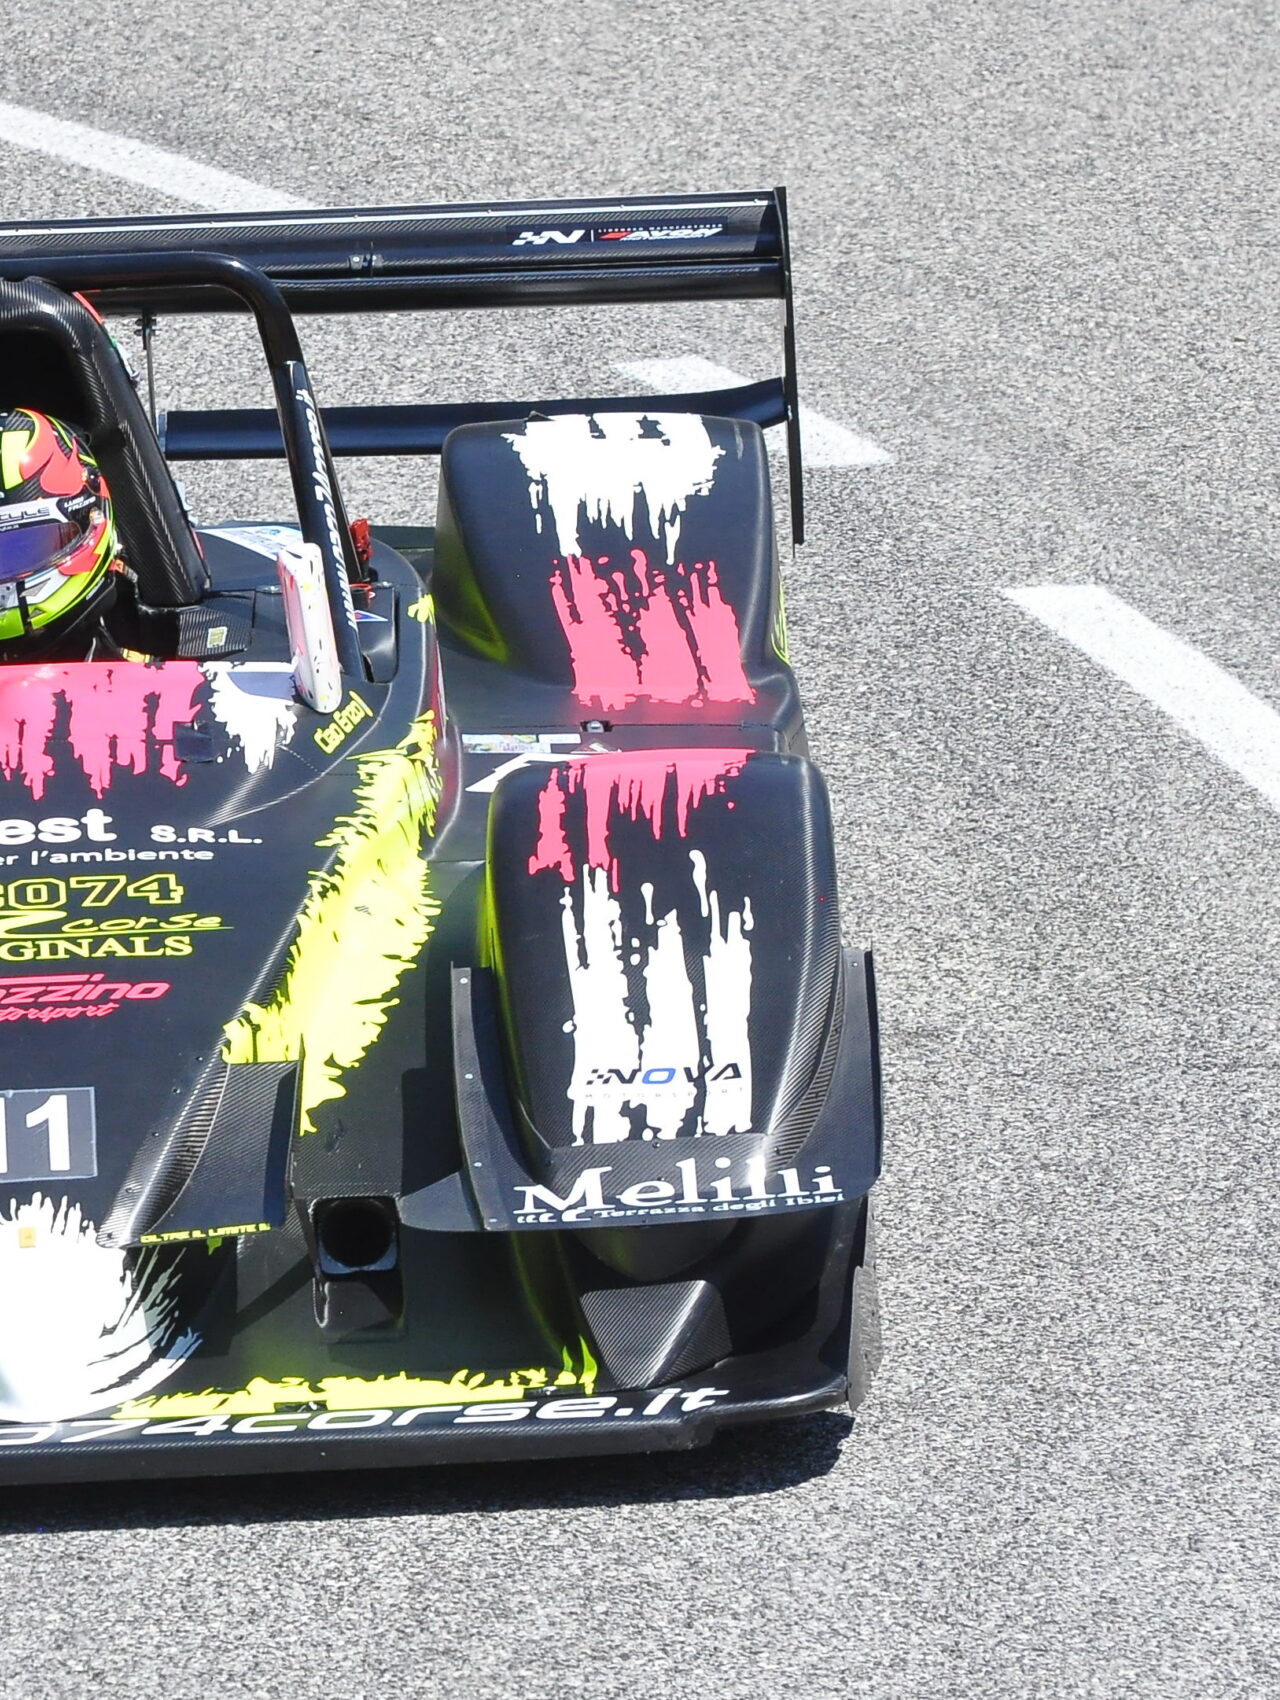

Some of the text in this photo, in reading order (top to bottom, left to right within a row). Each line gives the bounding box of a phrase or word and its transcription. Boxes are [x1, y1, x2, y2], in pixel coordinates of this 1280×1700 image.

[150, 824, 263, 844] S.R.L.
[31, 847, 214, 866] l'ambiente
[61, 912, 223, 934] corse
[600, 1062, 742, 1085] NOVA
[513, 1156, 842, 1215] Melilli
[593, 1193, 845, 1218] Terrazza degli Iblei
